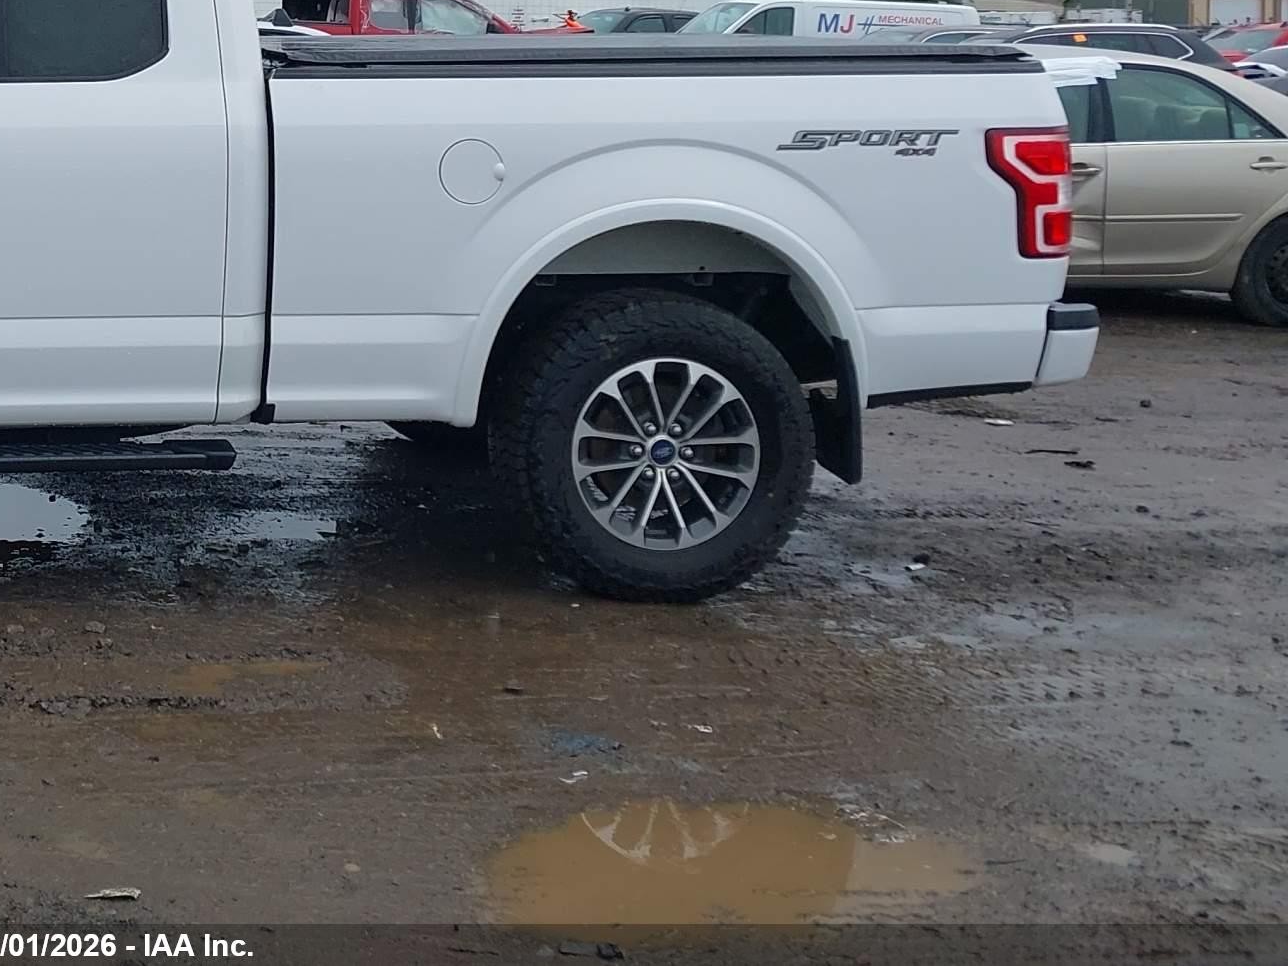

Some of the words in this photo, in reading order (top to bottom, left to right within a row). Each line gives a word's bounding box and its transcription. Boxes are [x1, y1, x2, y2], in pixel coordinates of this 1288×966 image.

[817, 13, 855, 34] MJ
[878, 15, 944, 26] MECHANICAL
[776, 129, 960, 151] SPORT
